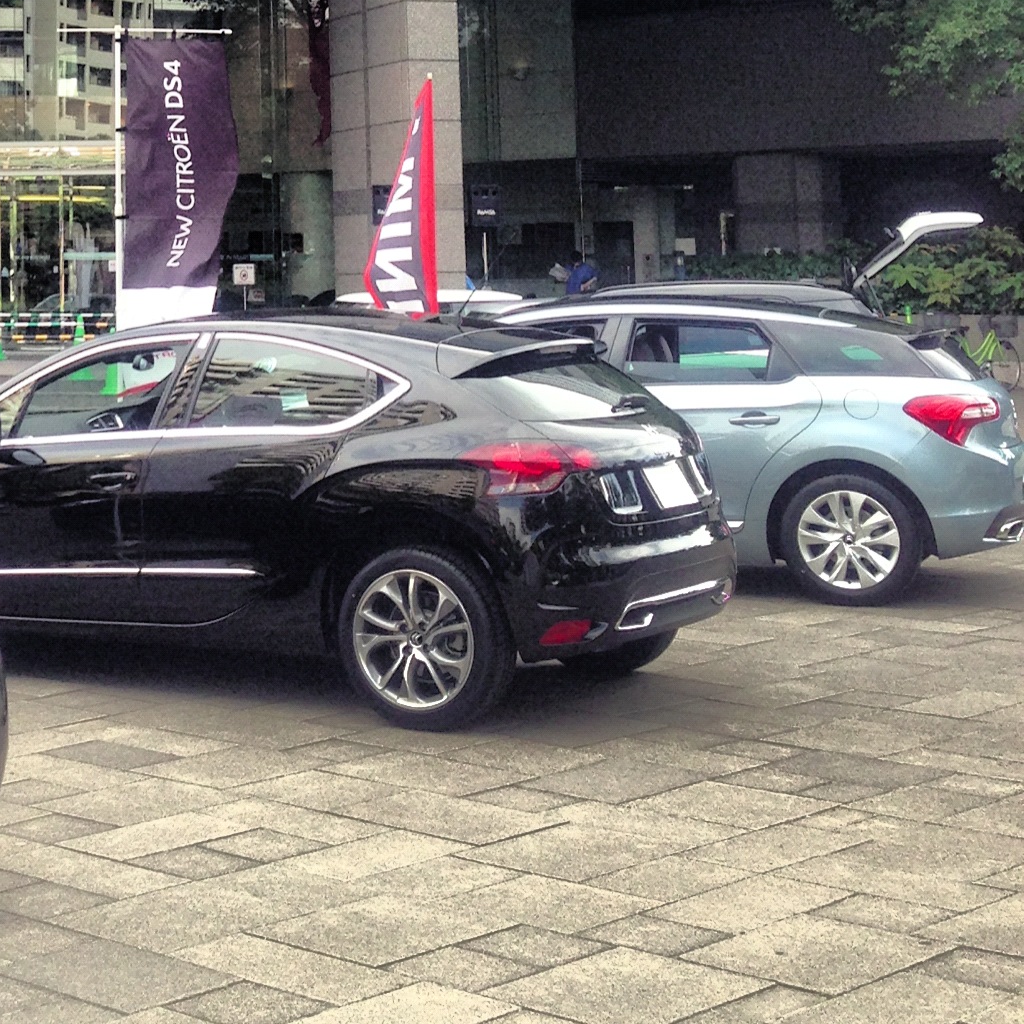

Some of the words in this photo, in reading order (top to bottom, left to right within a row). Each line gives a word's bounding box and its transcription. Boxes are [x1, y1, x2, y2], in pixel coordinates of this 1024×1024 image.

[163, 59, 184, 109] DS4
[166, 114, 196, 211] CITROËN
[166, 214, 194, 268] NEW
